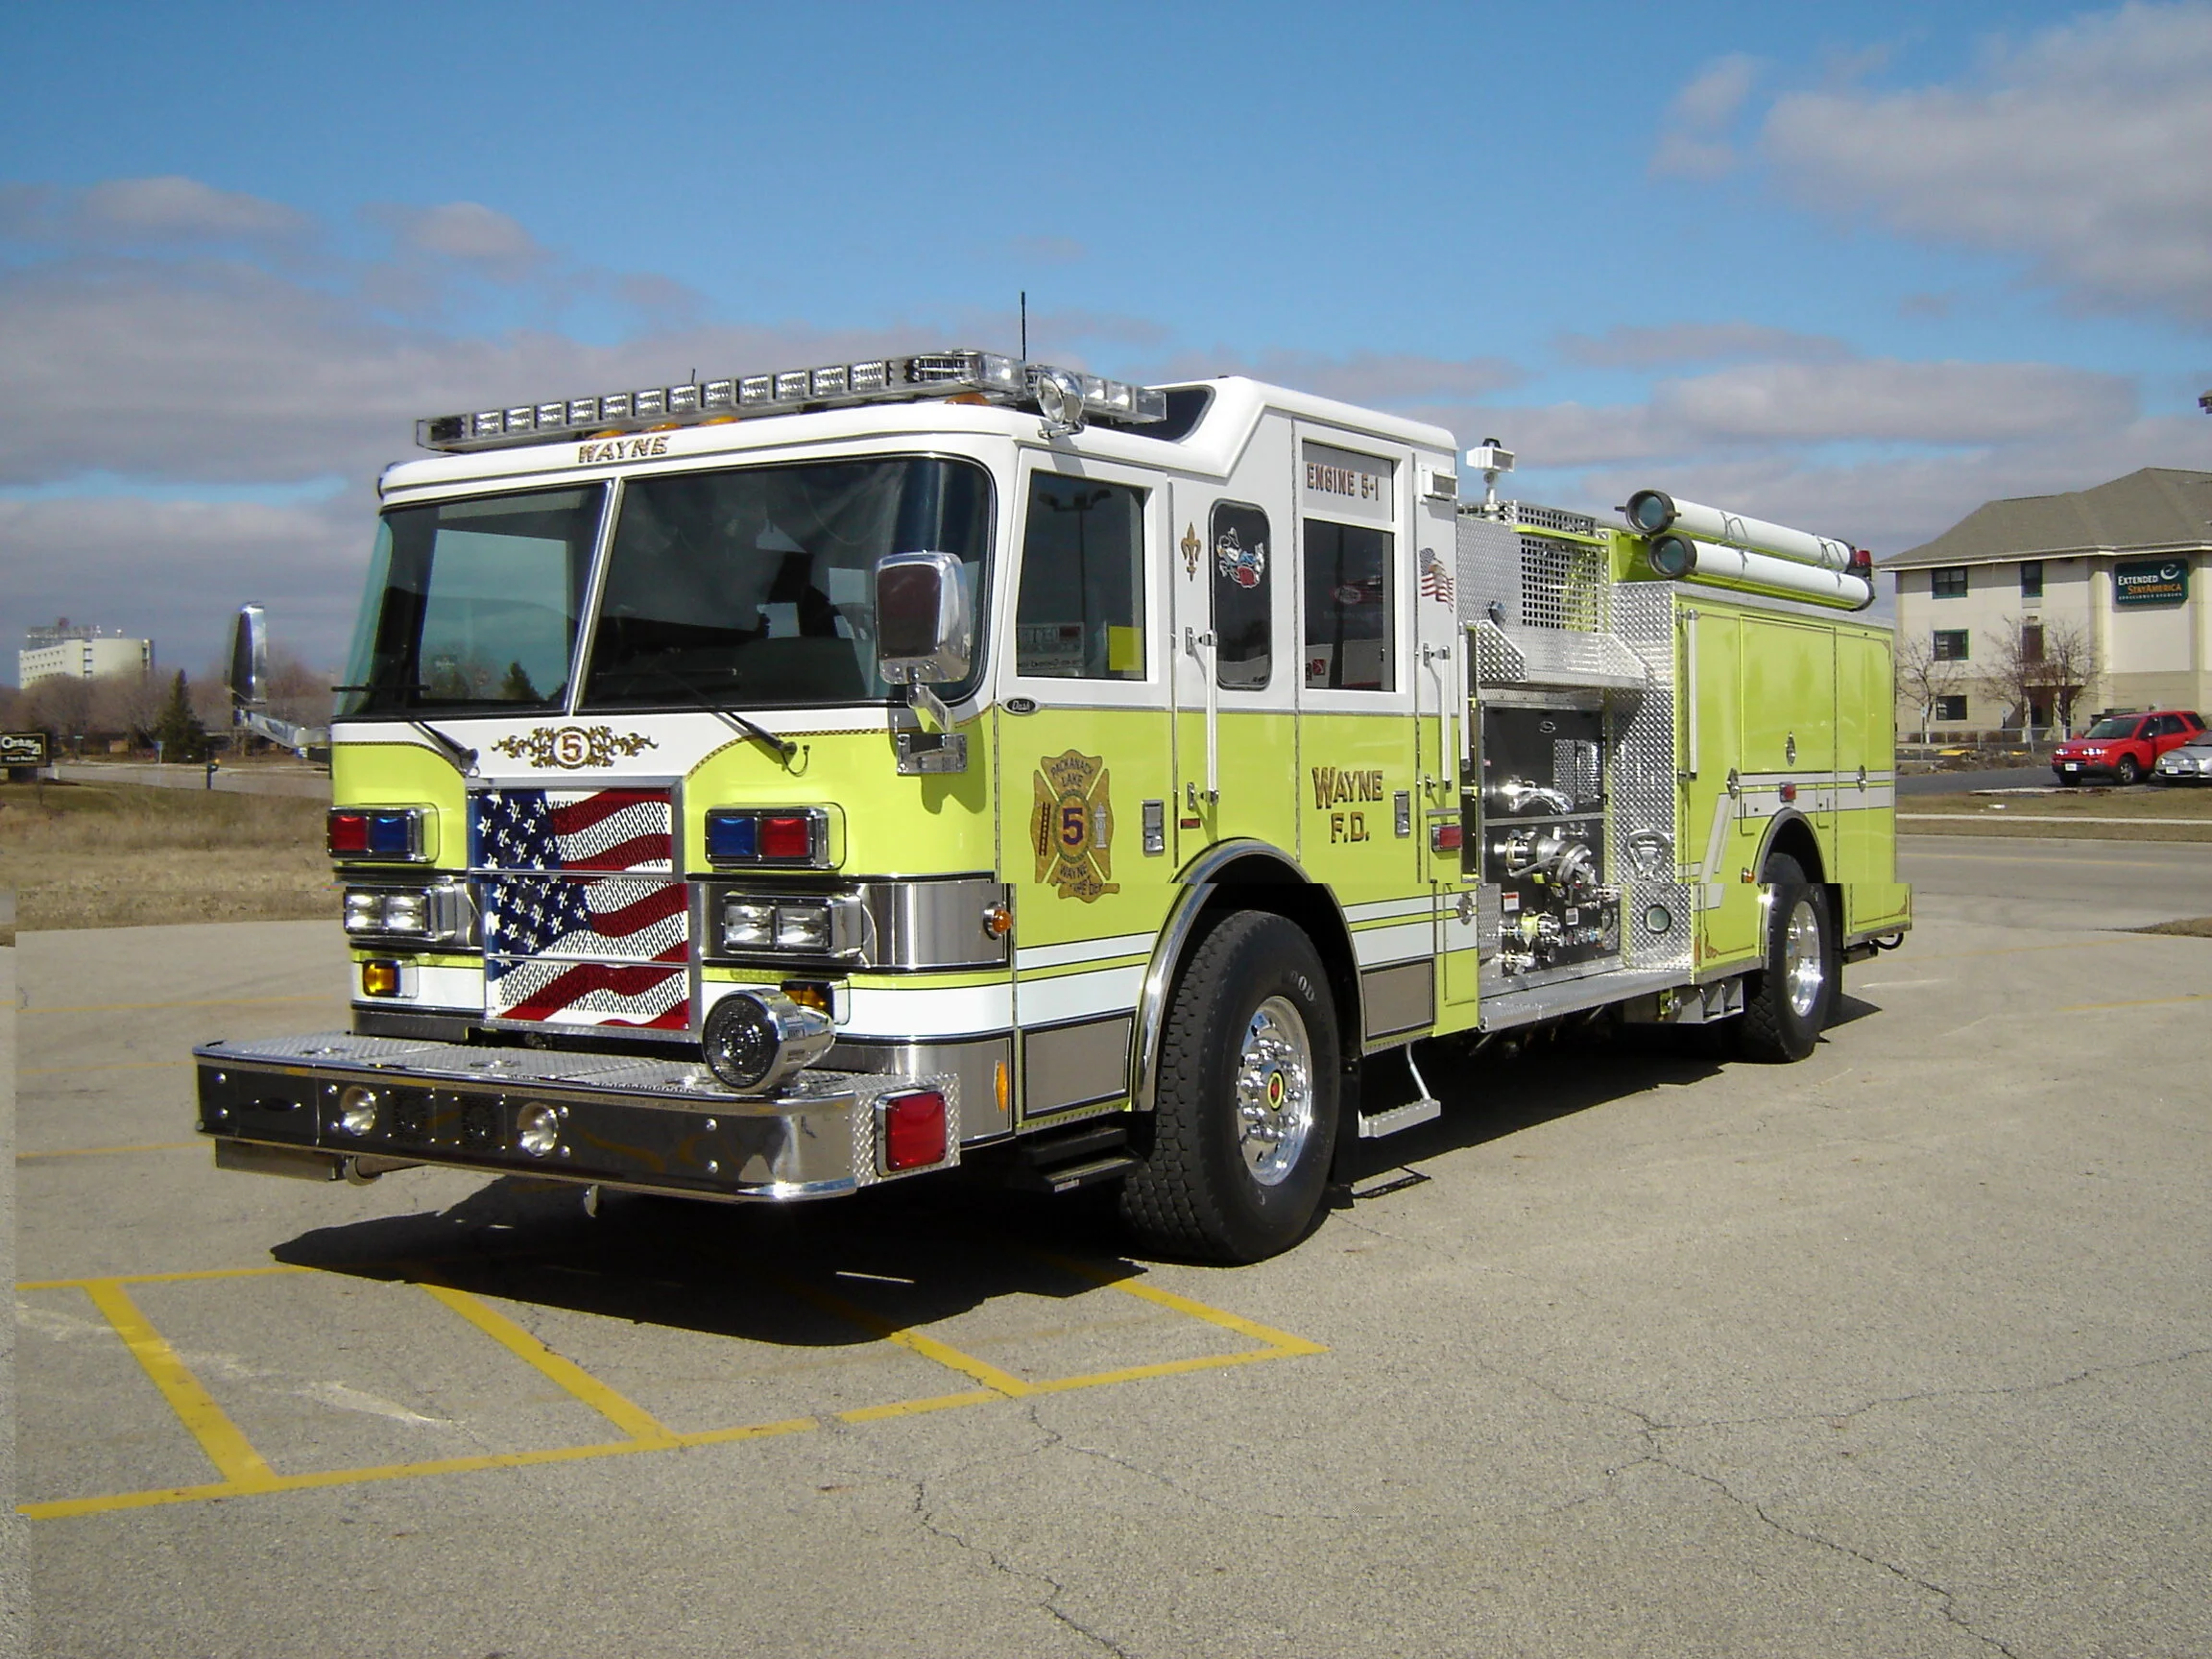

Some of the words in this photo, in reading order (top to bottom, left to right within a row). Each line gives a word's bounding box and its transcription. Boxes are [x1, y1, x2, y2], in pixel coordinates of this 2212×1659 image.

[578, 435, 670, 463] WAYNE
[1307, 463, 1355, 496] ENGINE
[1361, 473, 1379, 501] 5-1
[2118, 576, 2158, 586] EXTENDED
[563, 734, 583, 762] 5
[1061, 773, 1083, 787] LAKE
[1311, 767, 1383, 809] WAYNE
[1063, 807, 1084, 845] 5
[1331, 812, 1369, 844] F.D.
[1060, 861, 1087, 879] WAYNE
